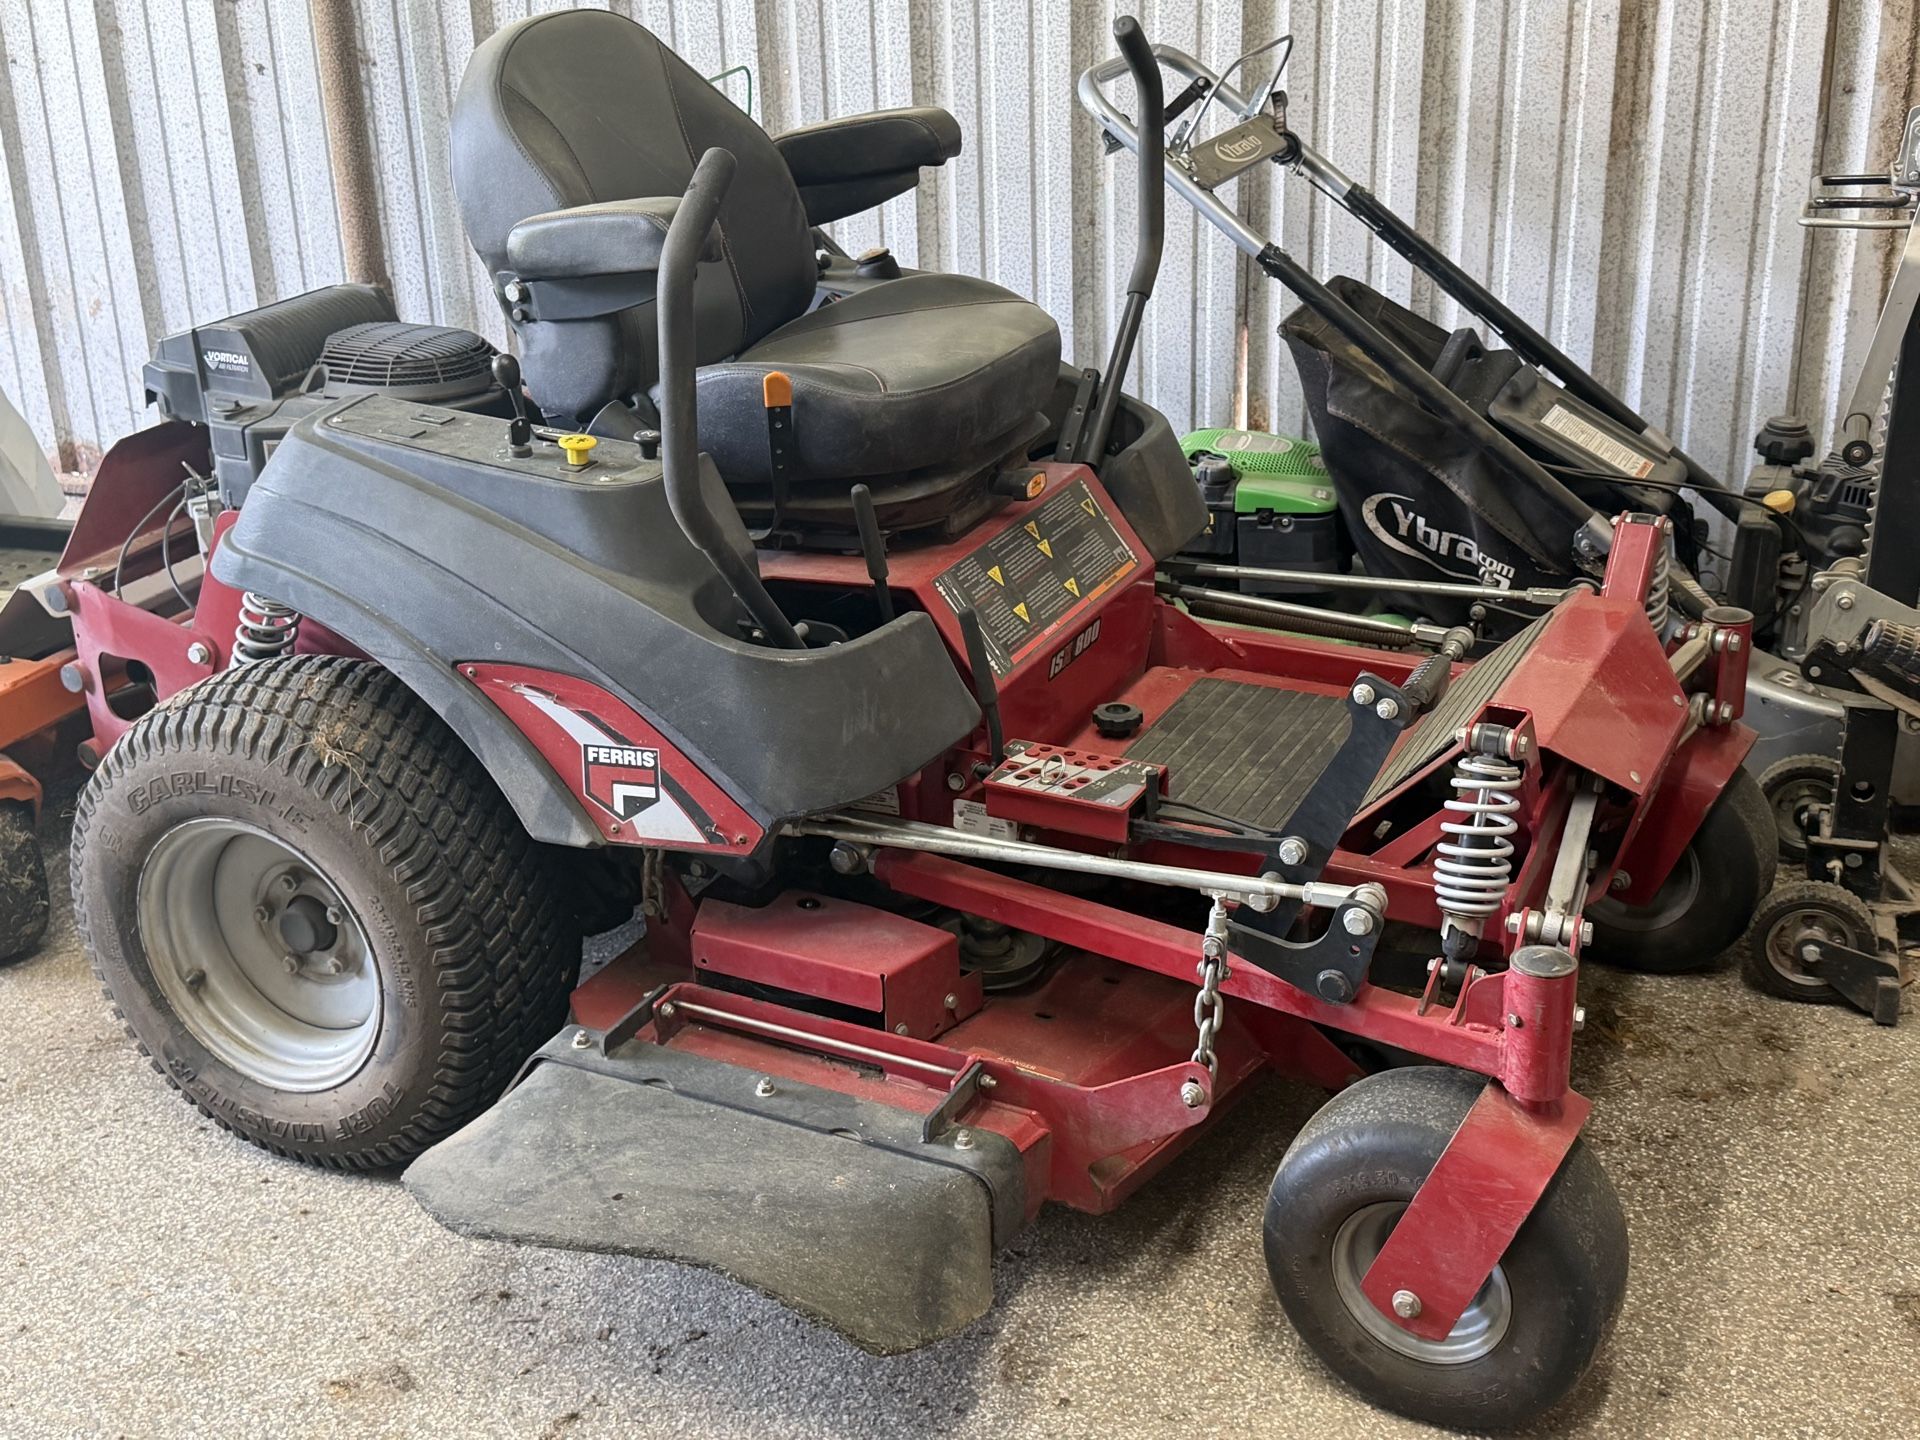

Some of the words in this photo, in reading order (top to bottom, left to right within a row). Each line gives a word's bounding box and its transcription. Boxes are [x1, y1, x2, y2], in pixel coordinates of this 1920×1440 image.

[207, 351, 249, 365] VORTICAL
[1075, 619, 1101, 657] 800
[587, 746, 656, 768] FERRIS
[127, 770, 315, 834] CARLISLE
[169, 1056, 326, 1143] MASTER
[335, 1081, 404, 1143] TURF
